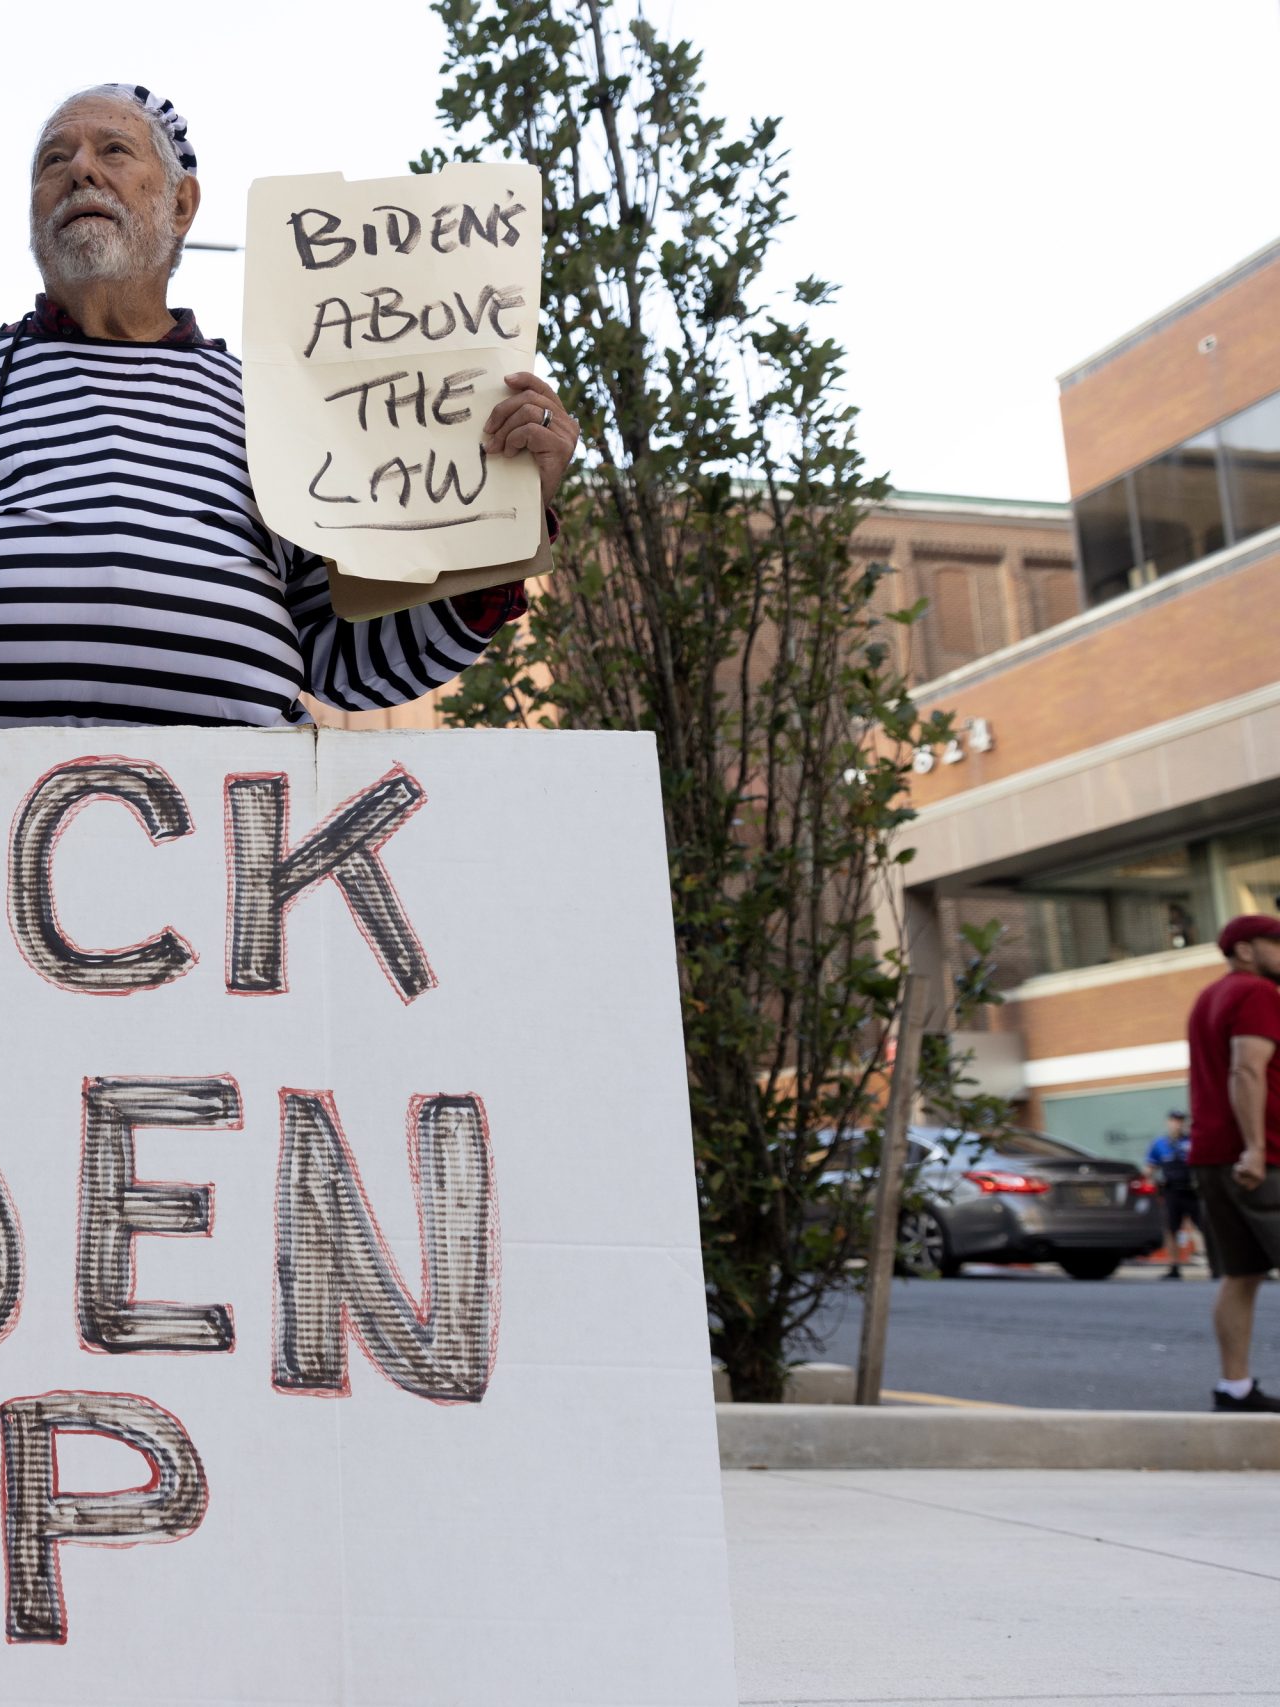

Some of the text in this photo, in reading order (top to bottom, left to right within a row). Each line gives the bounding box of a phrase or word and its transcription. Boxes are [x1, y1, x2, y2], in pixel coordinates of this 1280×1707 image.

[304, 284, 526, 359] ABOVE
[324, 367, 488, 433] THE
[308, 443, 488, 508] LAW
